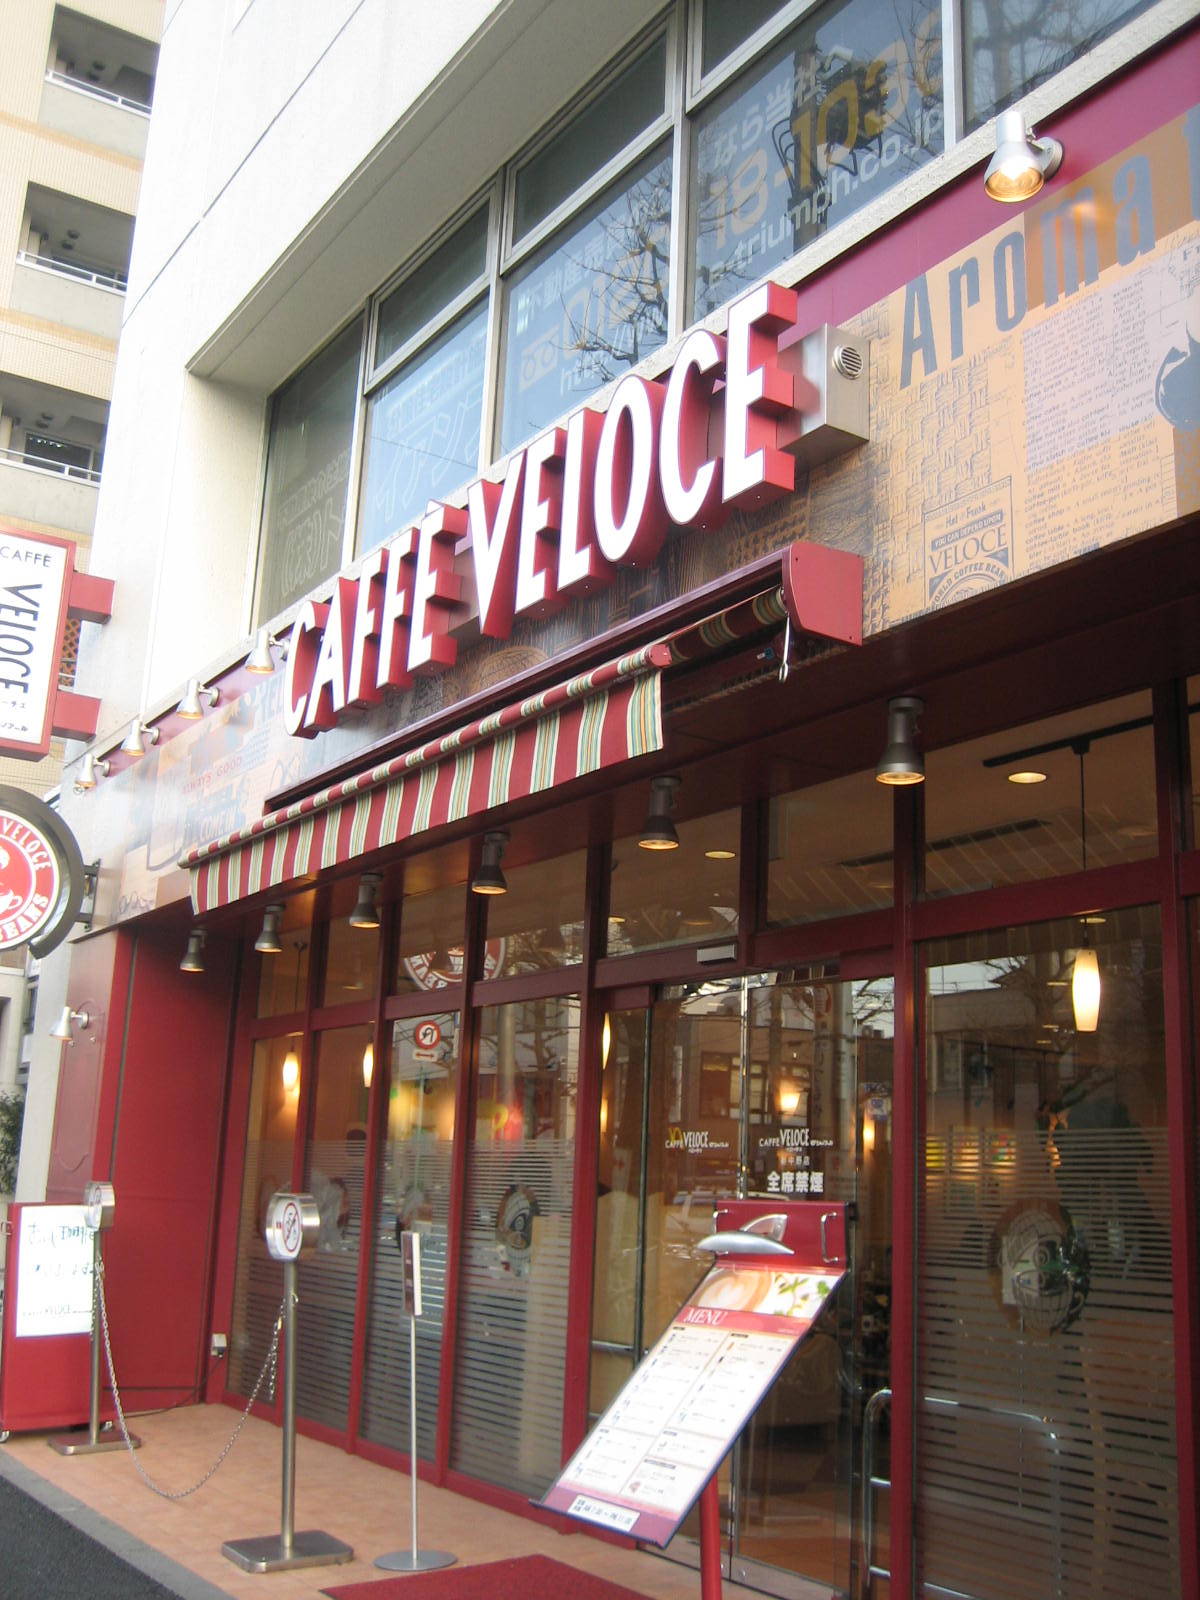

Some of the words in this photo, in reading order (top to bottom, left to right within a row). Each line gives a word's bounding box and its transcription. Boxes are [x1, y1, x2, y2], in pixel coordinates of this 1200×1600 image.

[467, 281, 784, 636] VELOCE
[929, 524, 1007, 574] VELOCE
[0, 583, 43, 694] VELOCE
[216, 758, 242, 777] GOOD
[2, 817, 51, 871] VELOCE
[683, 1131, 709, 1148] VELOCE
[780, 1128, 810, 1147] VELOCE
[767, 1170, 824, 1193] 全席禁煙
[683, 1307, 728, 1326] MENU
